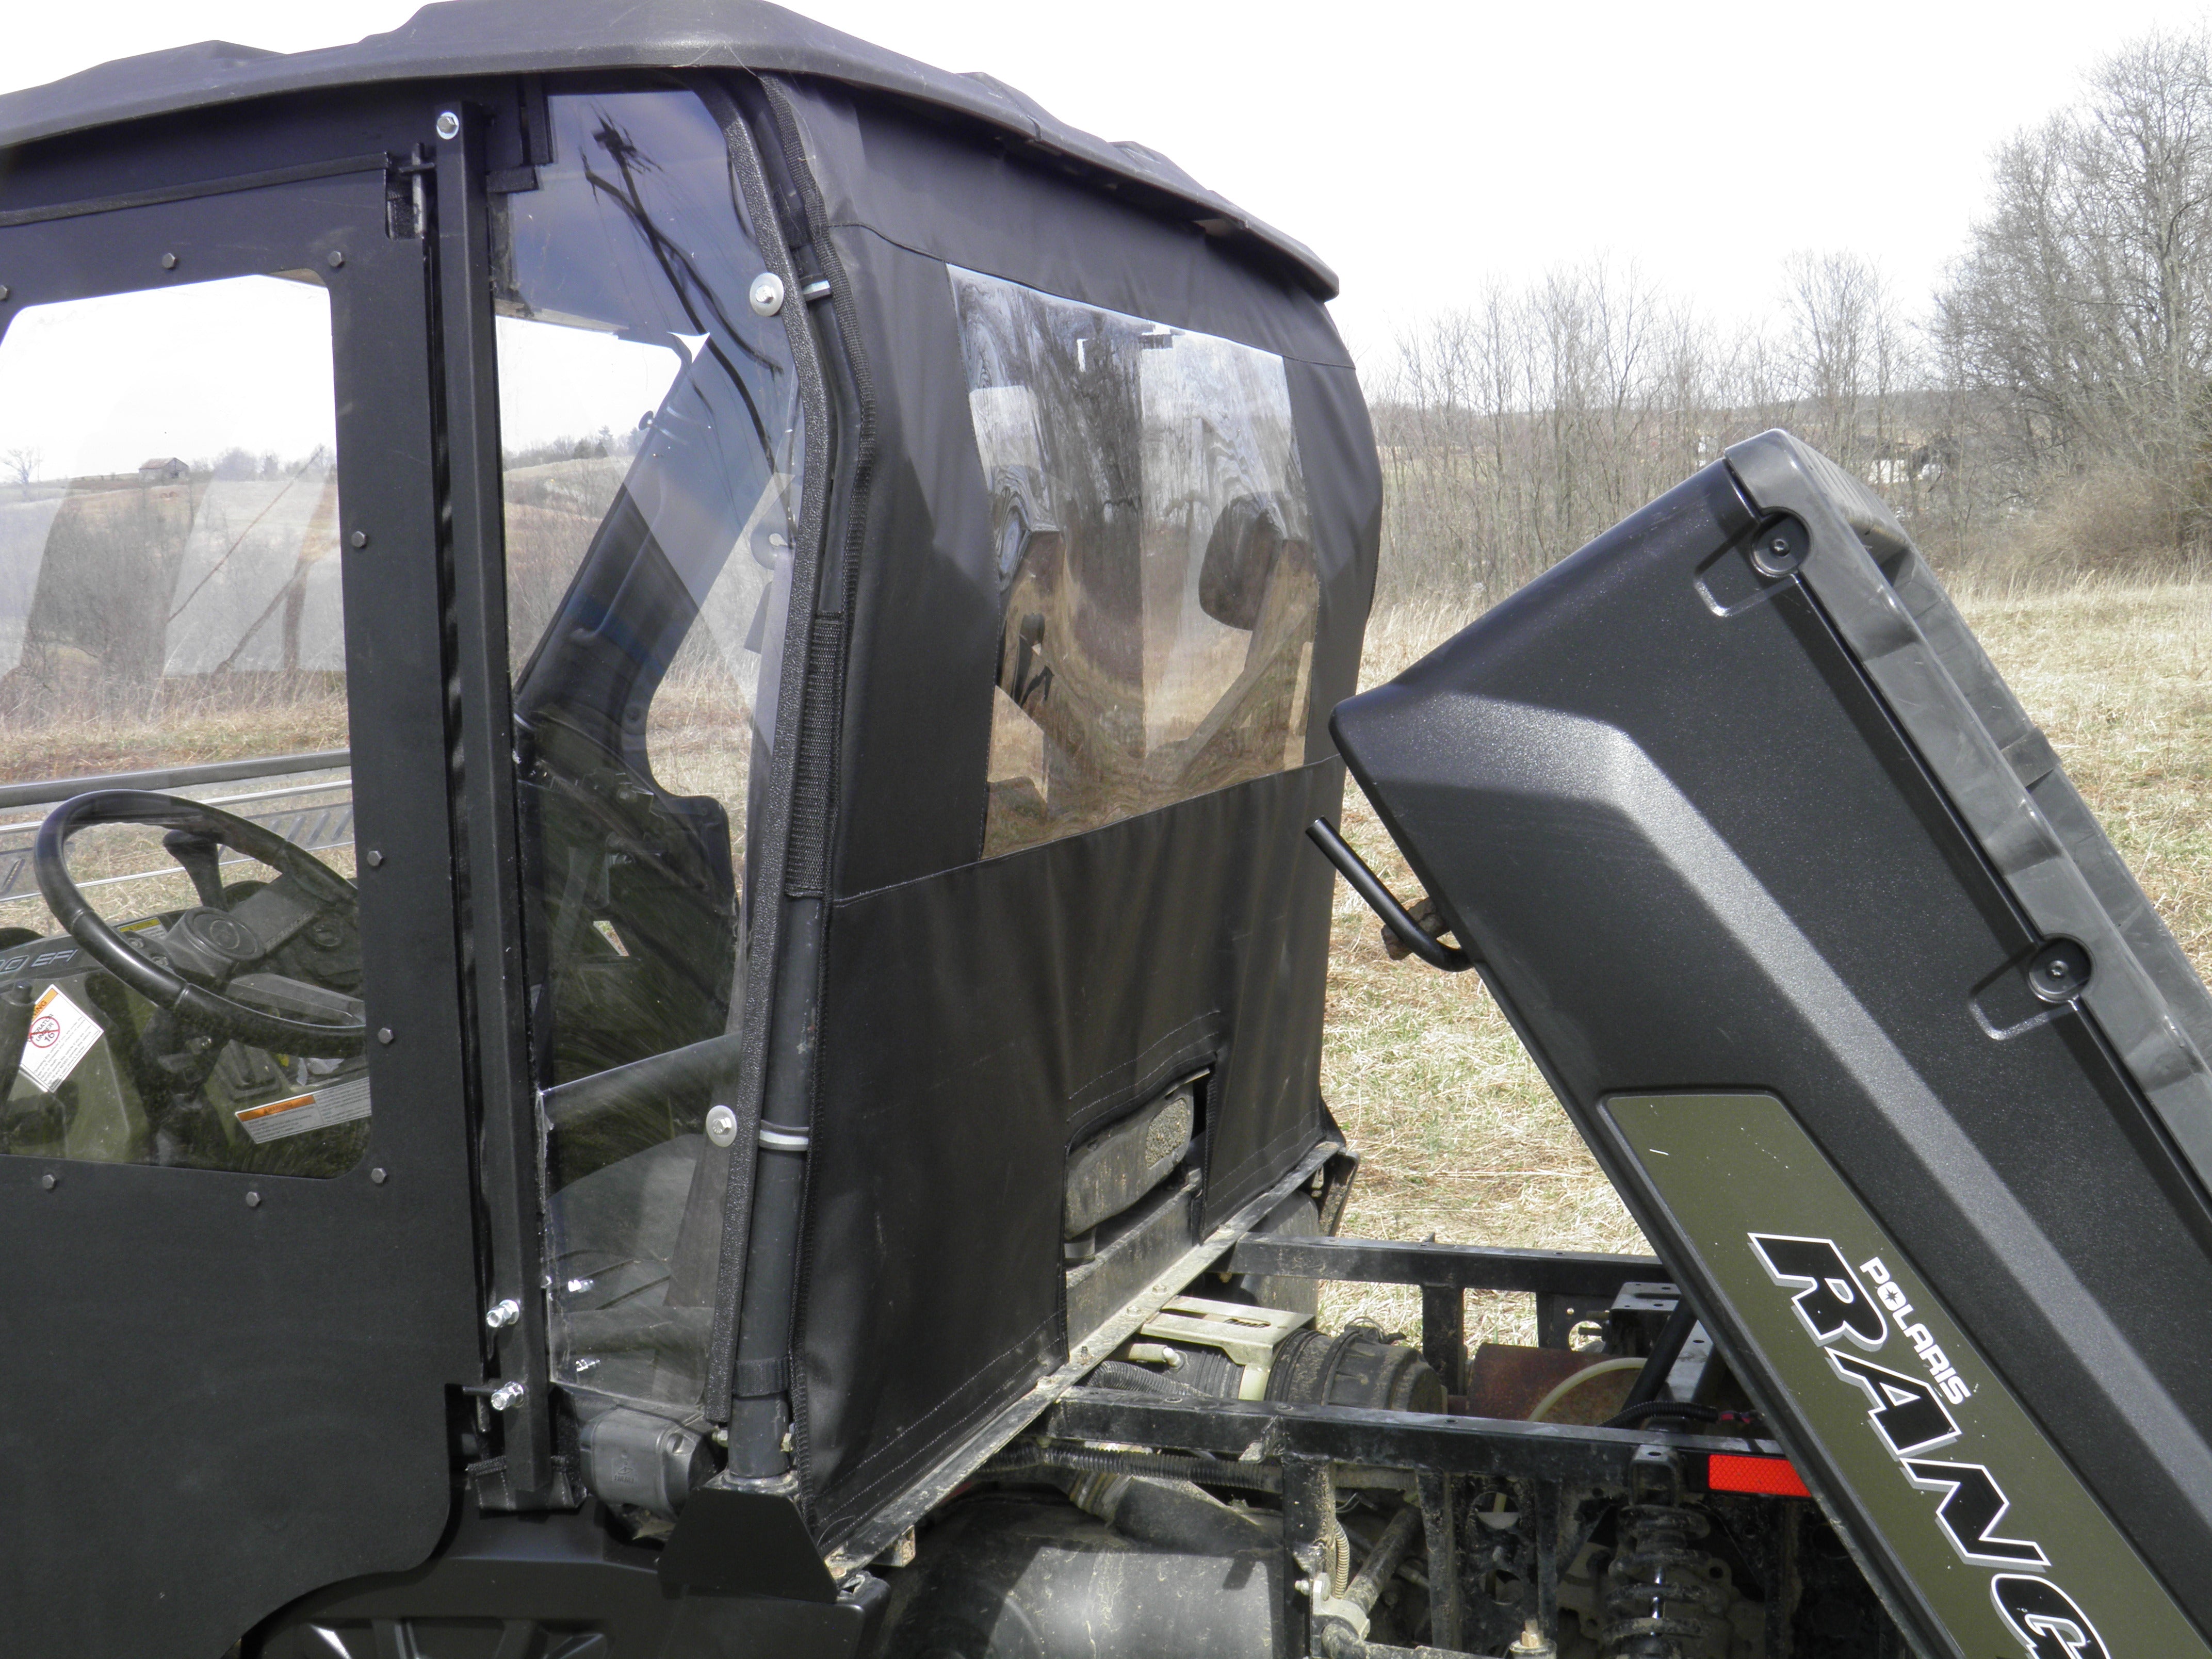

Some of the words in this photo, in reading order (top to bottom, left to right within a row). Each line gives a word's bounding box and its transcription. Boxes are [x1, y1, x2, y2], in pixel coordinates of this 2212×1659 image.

[31, 949, 78, 967] EFI
[44, 1032, 55, 1042] 16
[1859, 1257, 1972, 1404] POLARIS
